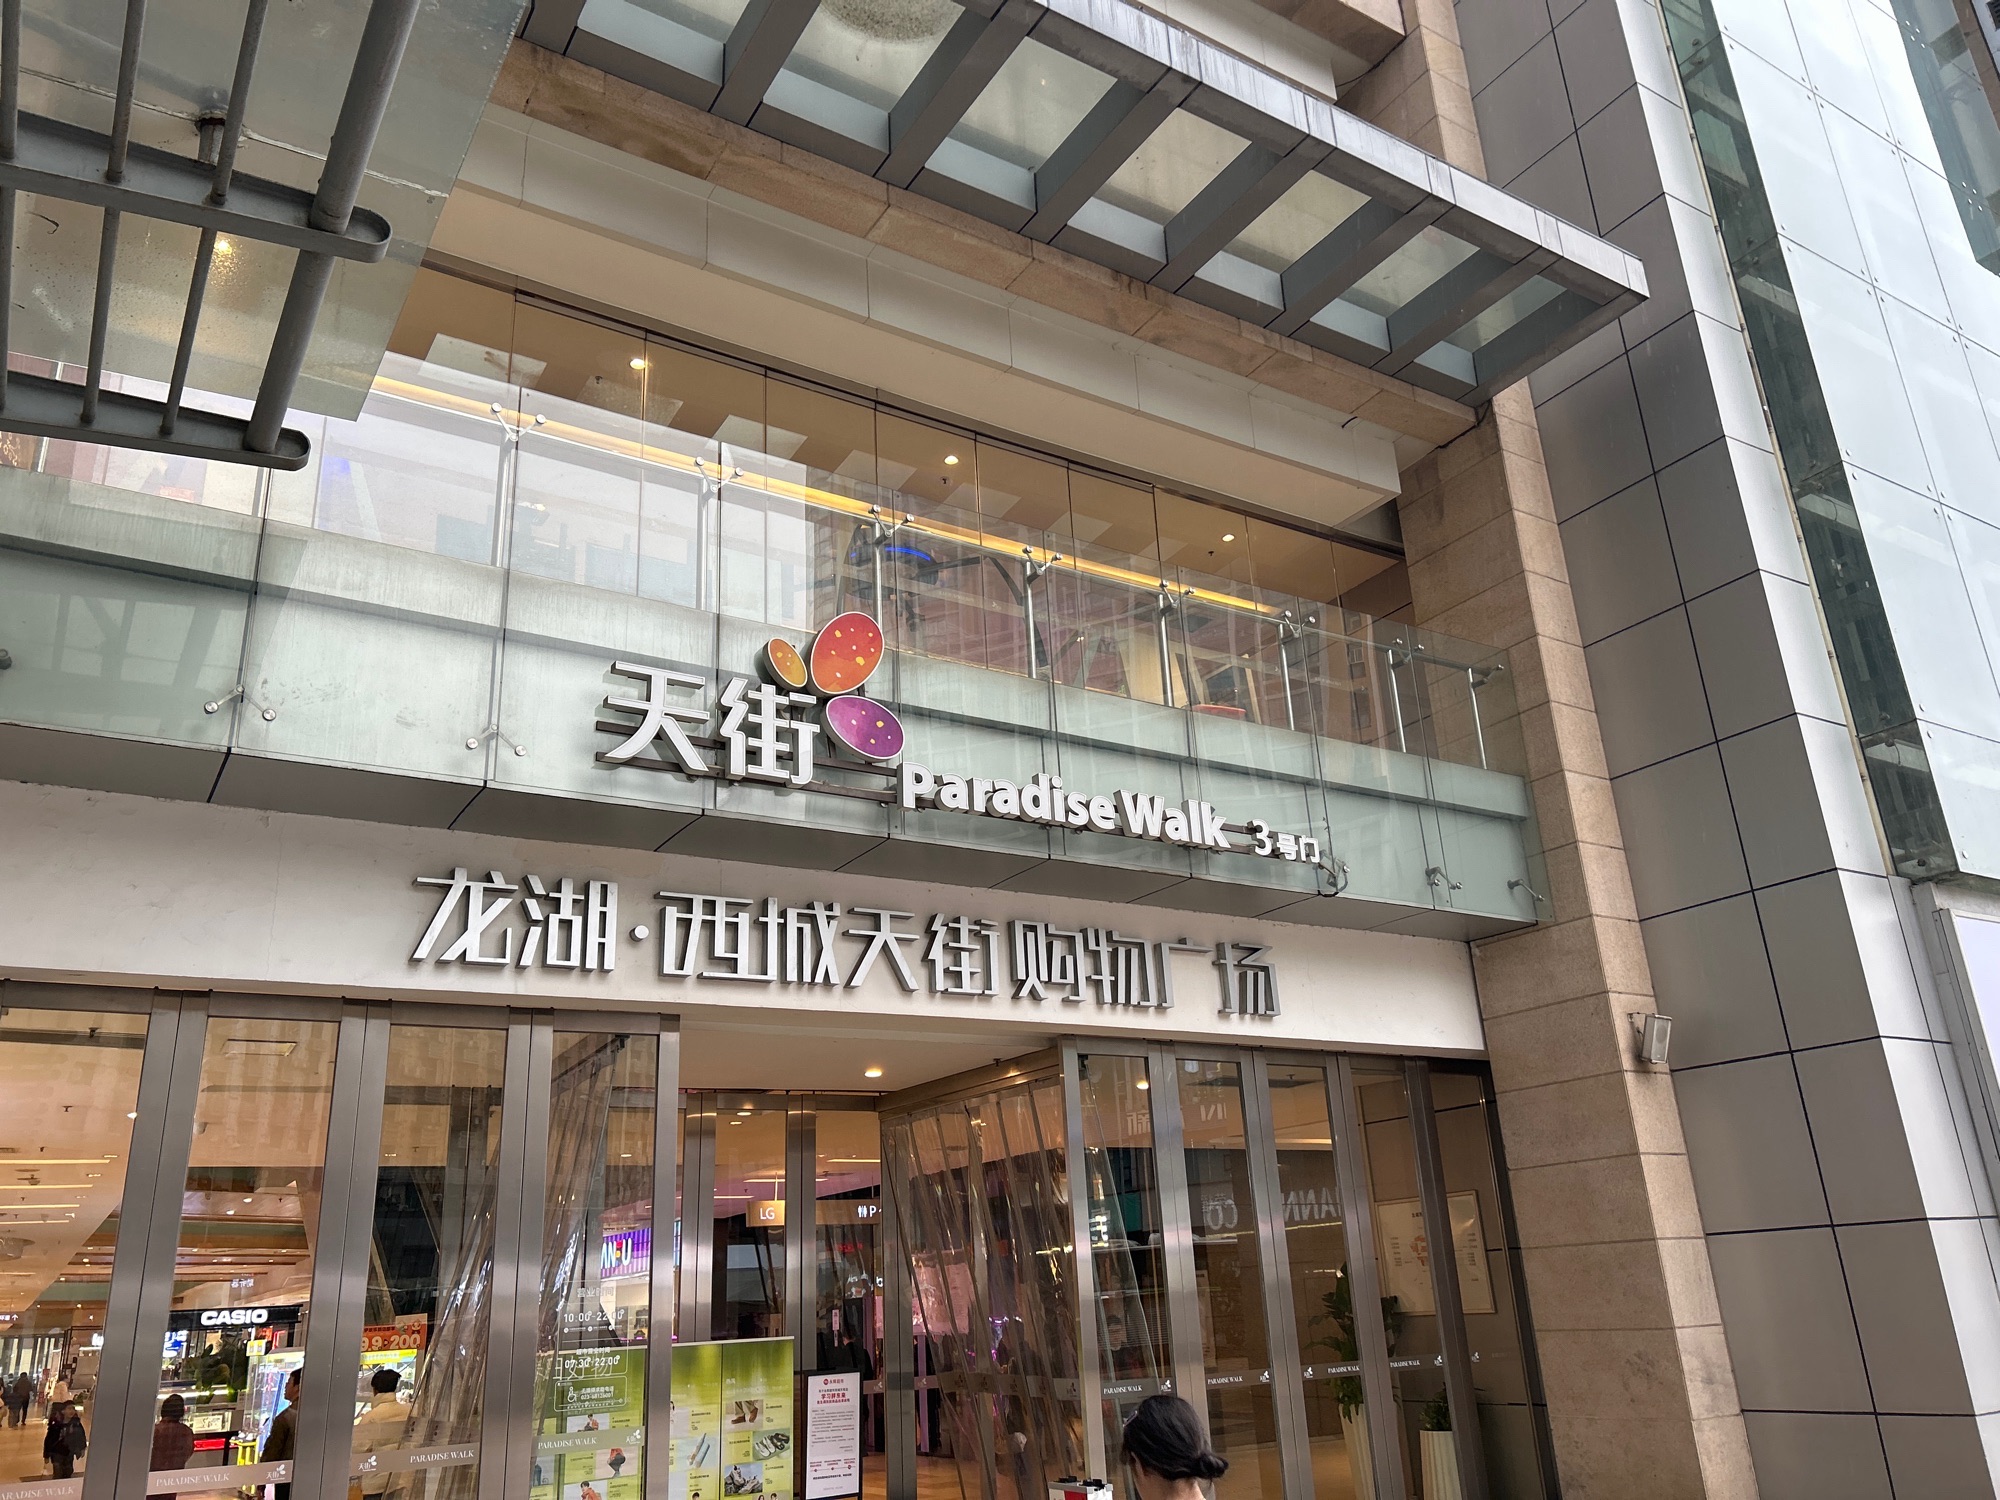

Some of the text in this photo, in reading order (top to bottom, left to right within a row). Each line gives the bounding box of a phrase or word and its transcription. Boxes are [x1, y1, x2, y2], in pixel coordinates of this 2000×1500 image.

[602, 660, 821, 788] 天街
[897, 761, 1320, 863] Paradise Walk 3号门
[759, 1207, 775, 1220] LG
[200, 1308, 268, 1326] CASIO
[1103, 1386, 1128, 1394] PARADISE
[538, 1437, 597, 1449] PARADISE WALK
[410, 1450, 474, 1464] PARADISE WALK
[156, 1473, 230, 1487] PARADISE WALK
[45, 1486, 74, 1496] WALK
